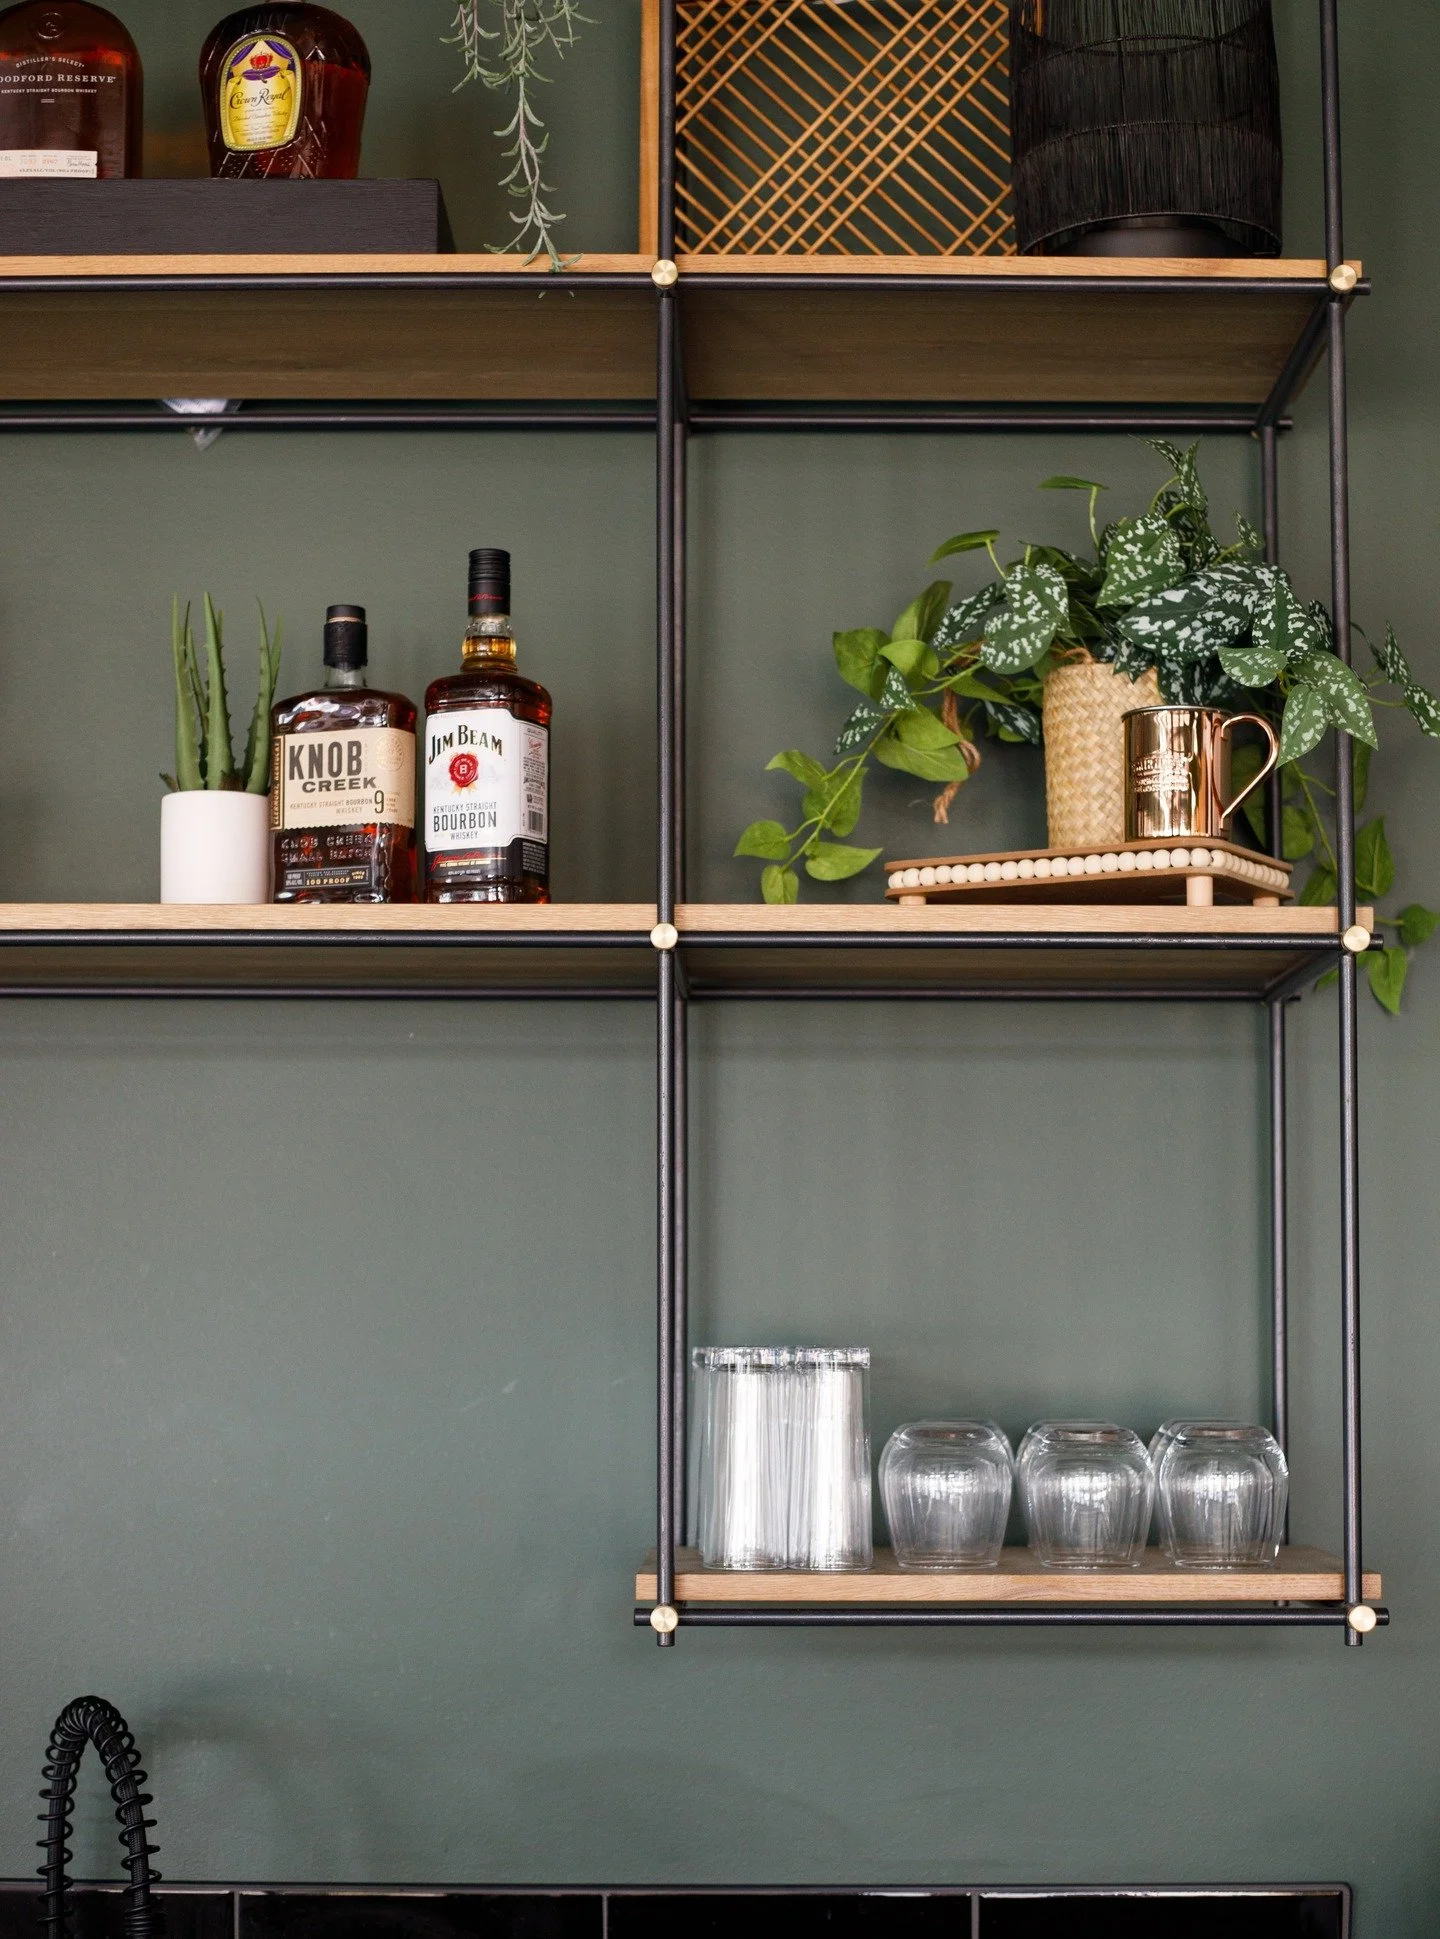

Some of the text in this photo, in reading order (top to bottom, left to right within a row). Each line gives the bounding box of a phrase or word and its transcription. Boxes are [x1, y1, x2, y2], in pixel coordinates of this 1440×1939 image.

[15, 56, 82, 68] DISTILLER'S SELECT
[57, 73, 114, 83] RESERVE
[229, 86, 291, 109] Crown Royal
[288, 740, 362, 781] KNOB
[459, 764, 468, 774] B
[302, 776, 377, 793] CREEK
[290, 798, 373, 810] KENTUCKY STRAIGHT BOURBON
[374, 789, 385, 814] 9
[433, 801, 497, 814] KENTUCKY STRAIGHT
[335, 806, 363, 815] WHISKEY
[433, 811, 497, 832] BOURBON
[450, 831, 478, 840] WHISKEY
[323, 877, 350, 886] PROOF
